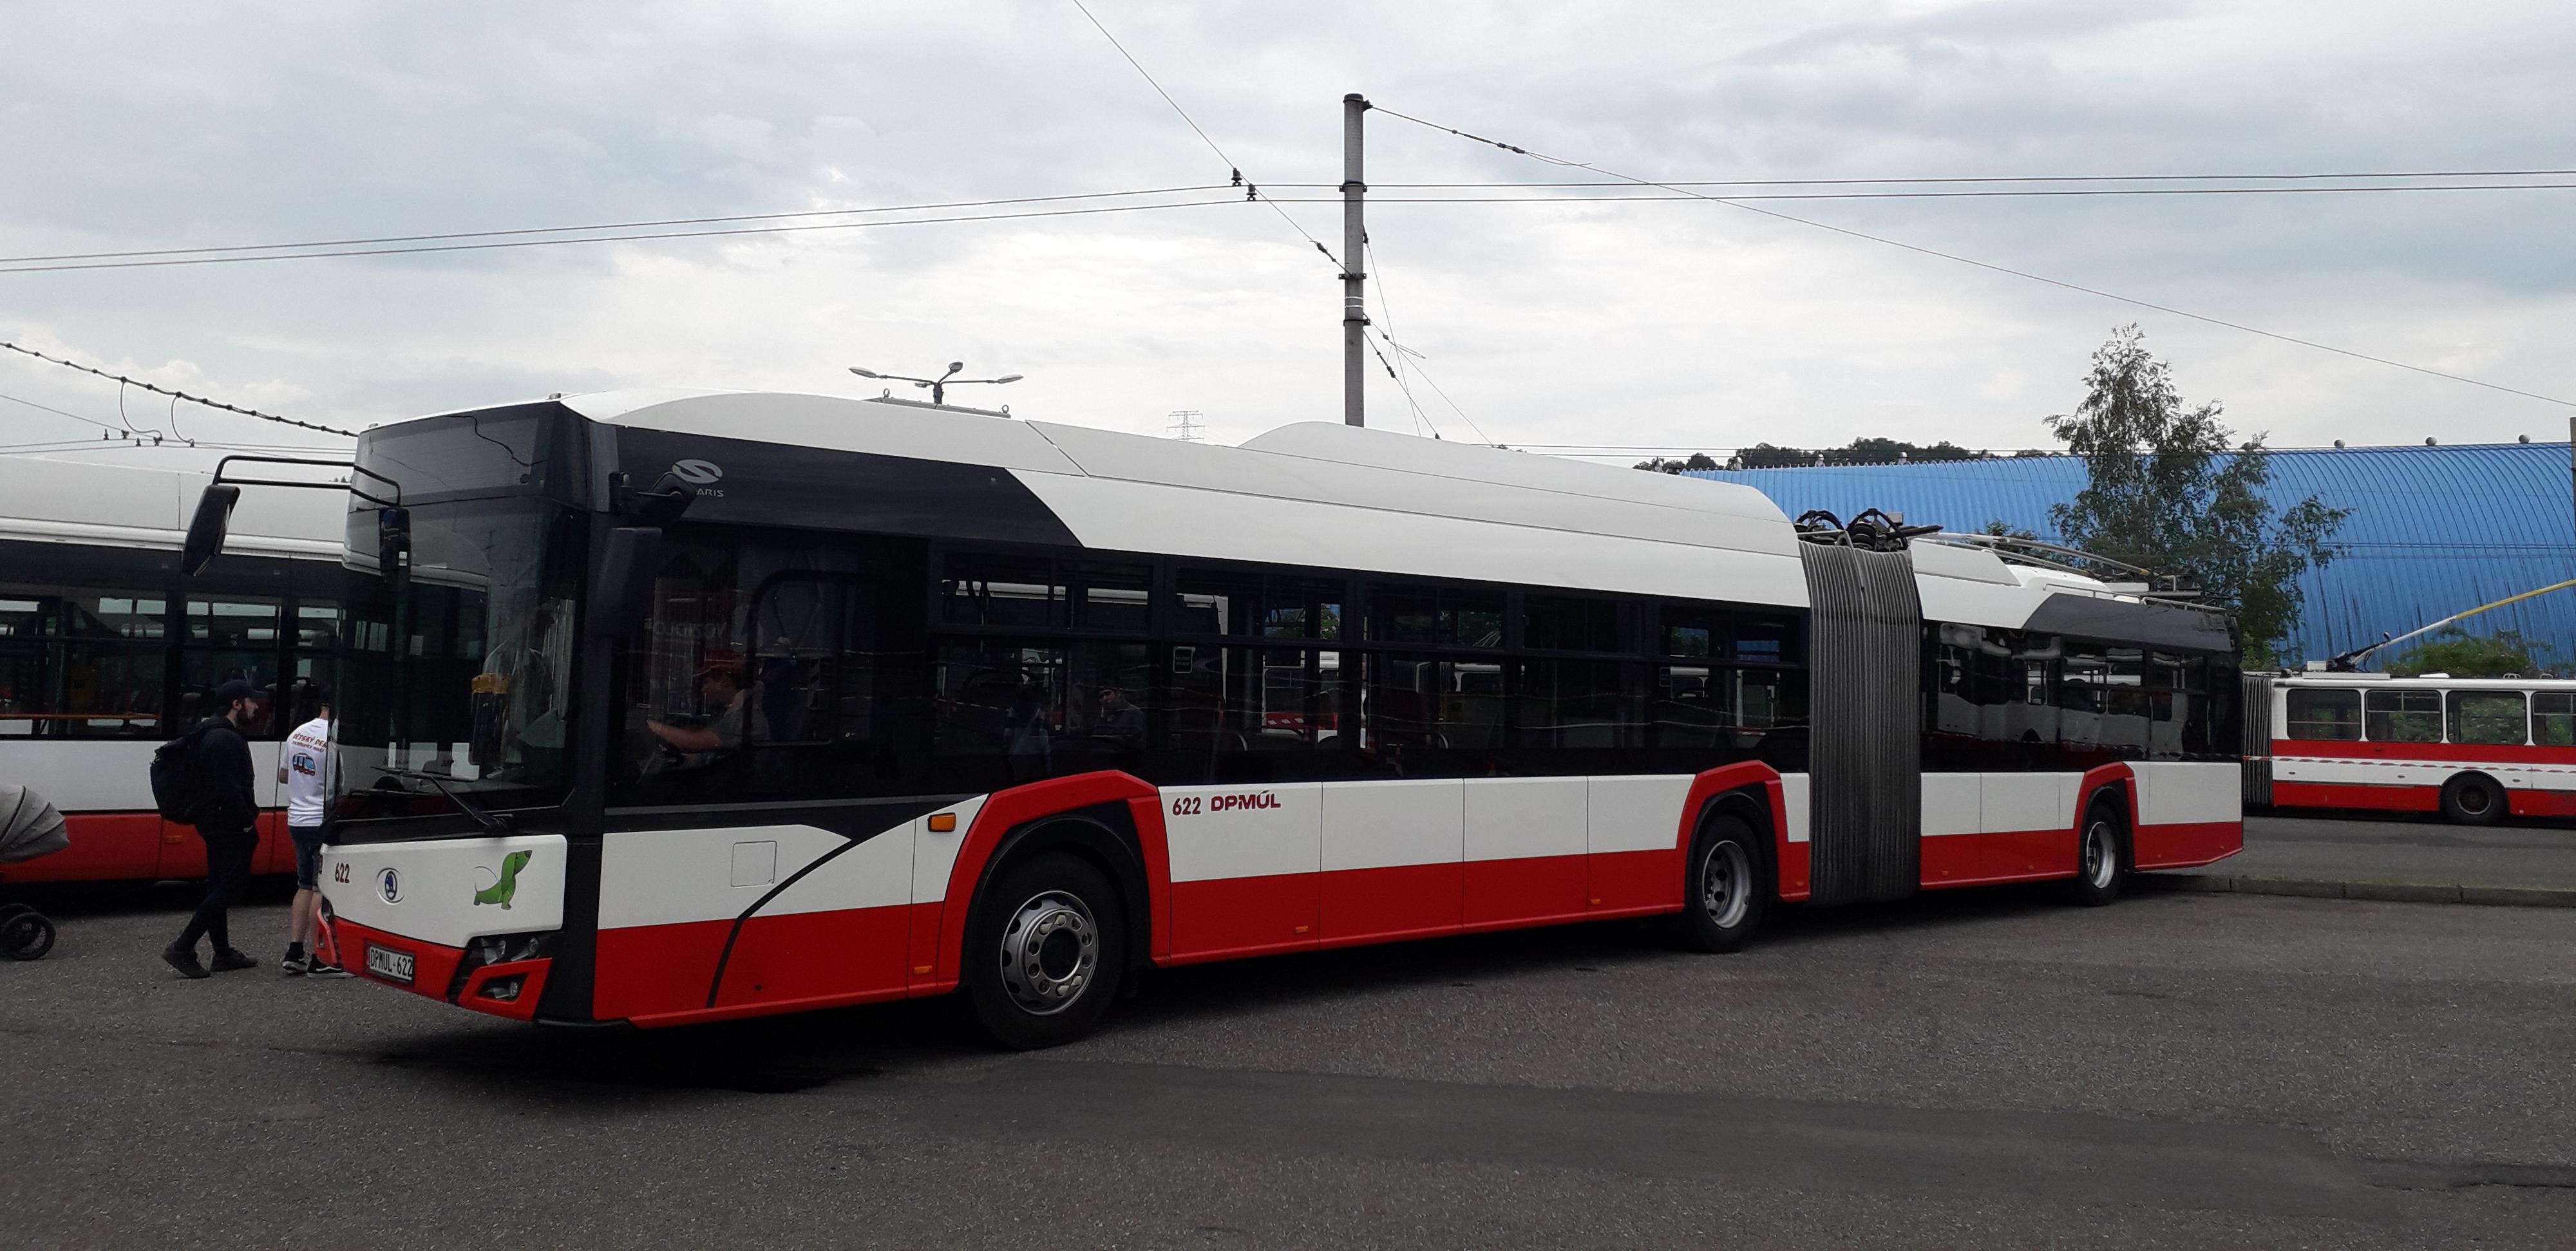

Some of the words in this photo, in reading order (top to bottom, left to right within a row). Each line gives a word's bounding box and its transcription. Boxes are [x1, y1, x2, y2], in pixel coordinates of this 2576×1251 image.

[696, 488, 724, 497] ARIS
[1172, 797, 1202, 816] 622
[1211, 790, 1282, 811] DPMÚL
[335, 862, 350, 883] 622
